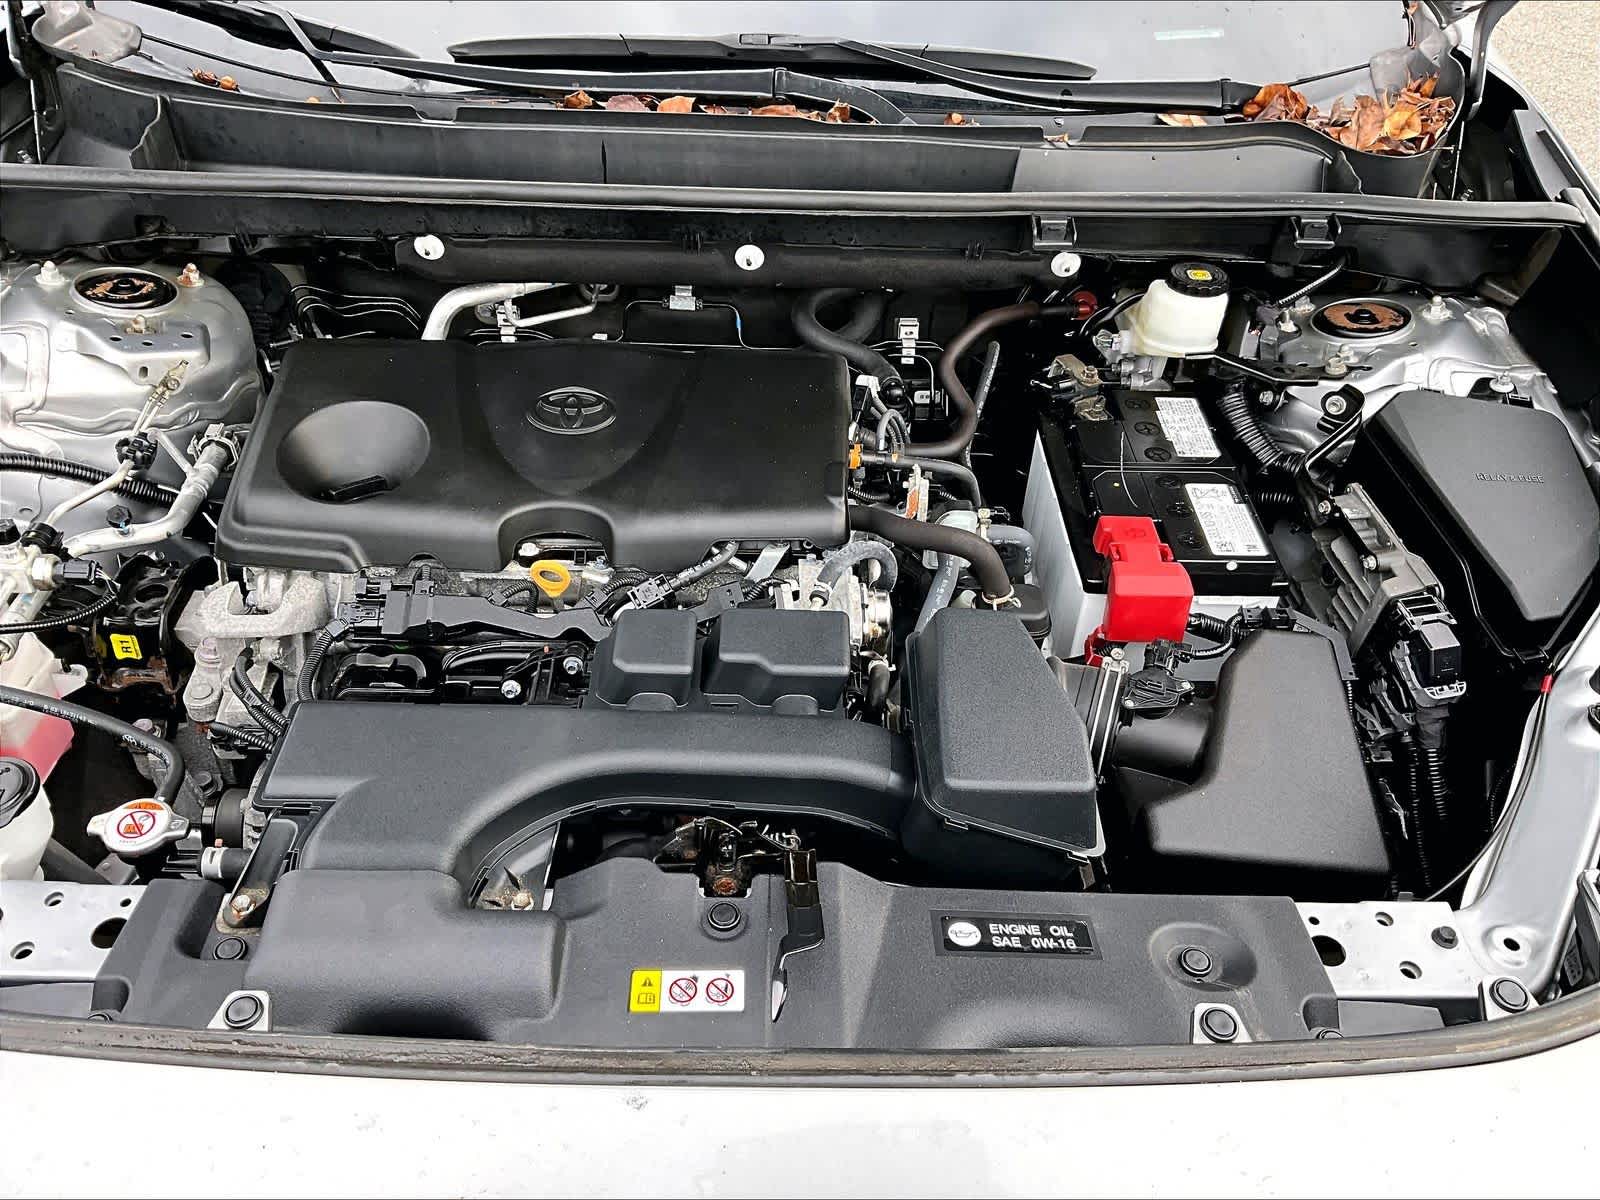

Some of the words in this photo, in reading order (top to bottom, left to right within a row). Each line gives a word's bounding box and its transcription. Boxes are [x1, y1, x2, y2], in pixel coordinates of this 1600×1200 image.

[1474, 472, 1506, 482] RELAY
[1518, 474, 1545, 484] FUSE
[989, 923, 1042, 936] ENGINE
[1049, 925, 1074, 937] OIL
[991, 935, 1022, 948] SAE
[1031, 938, 1077, 949] 0W-16
